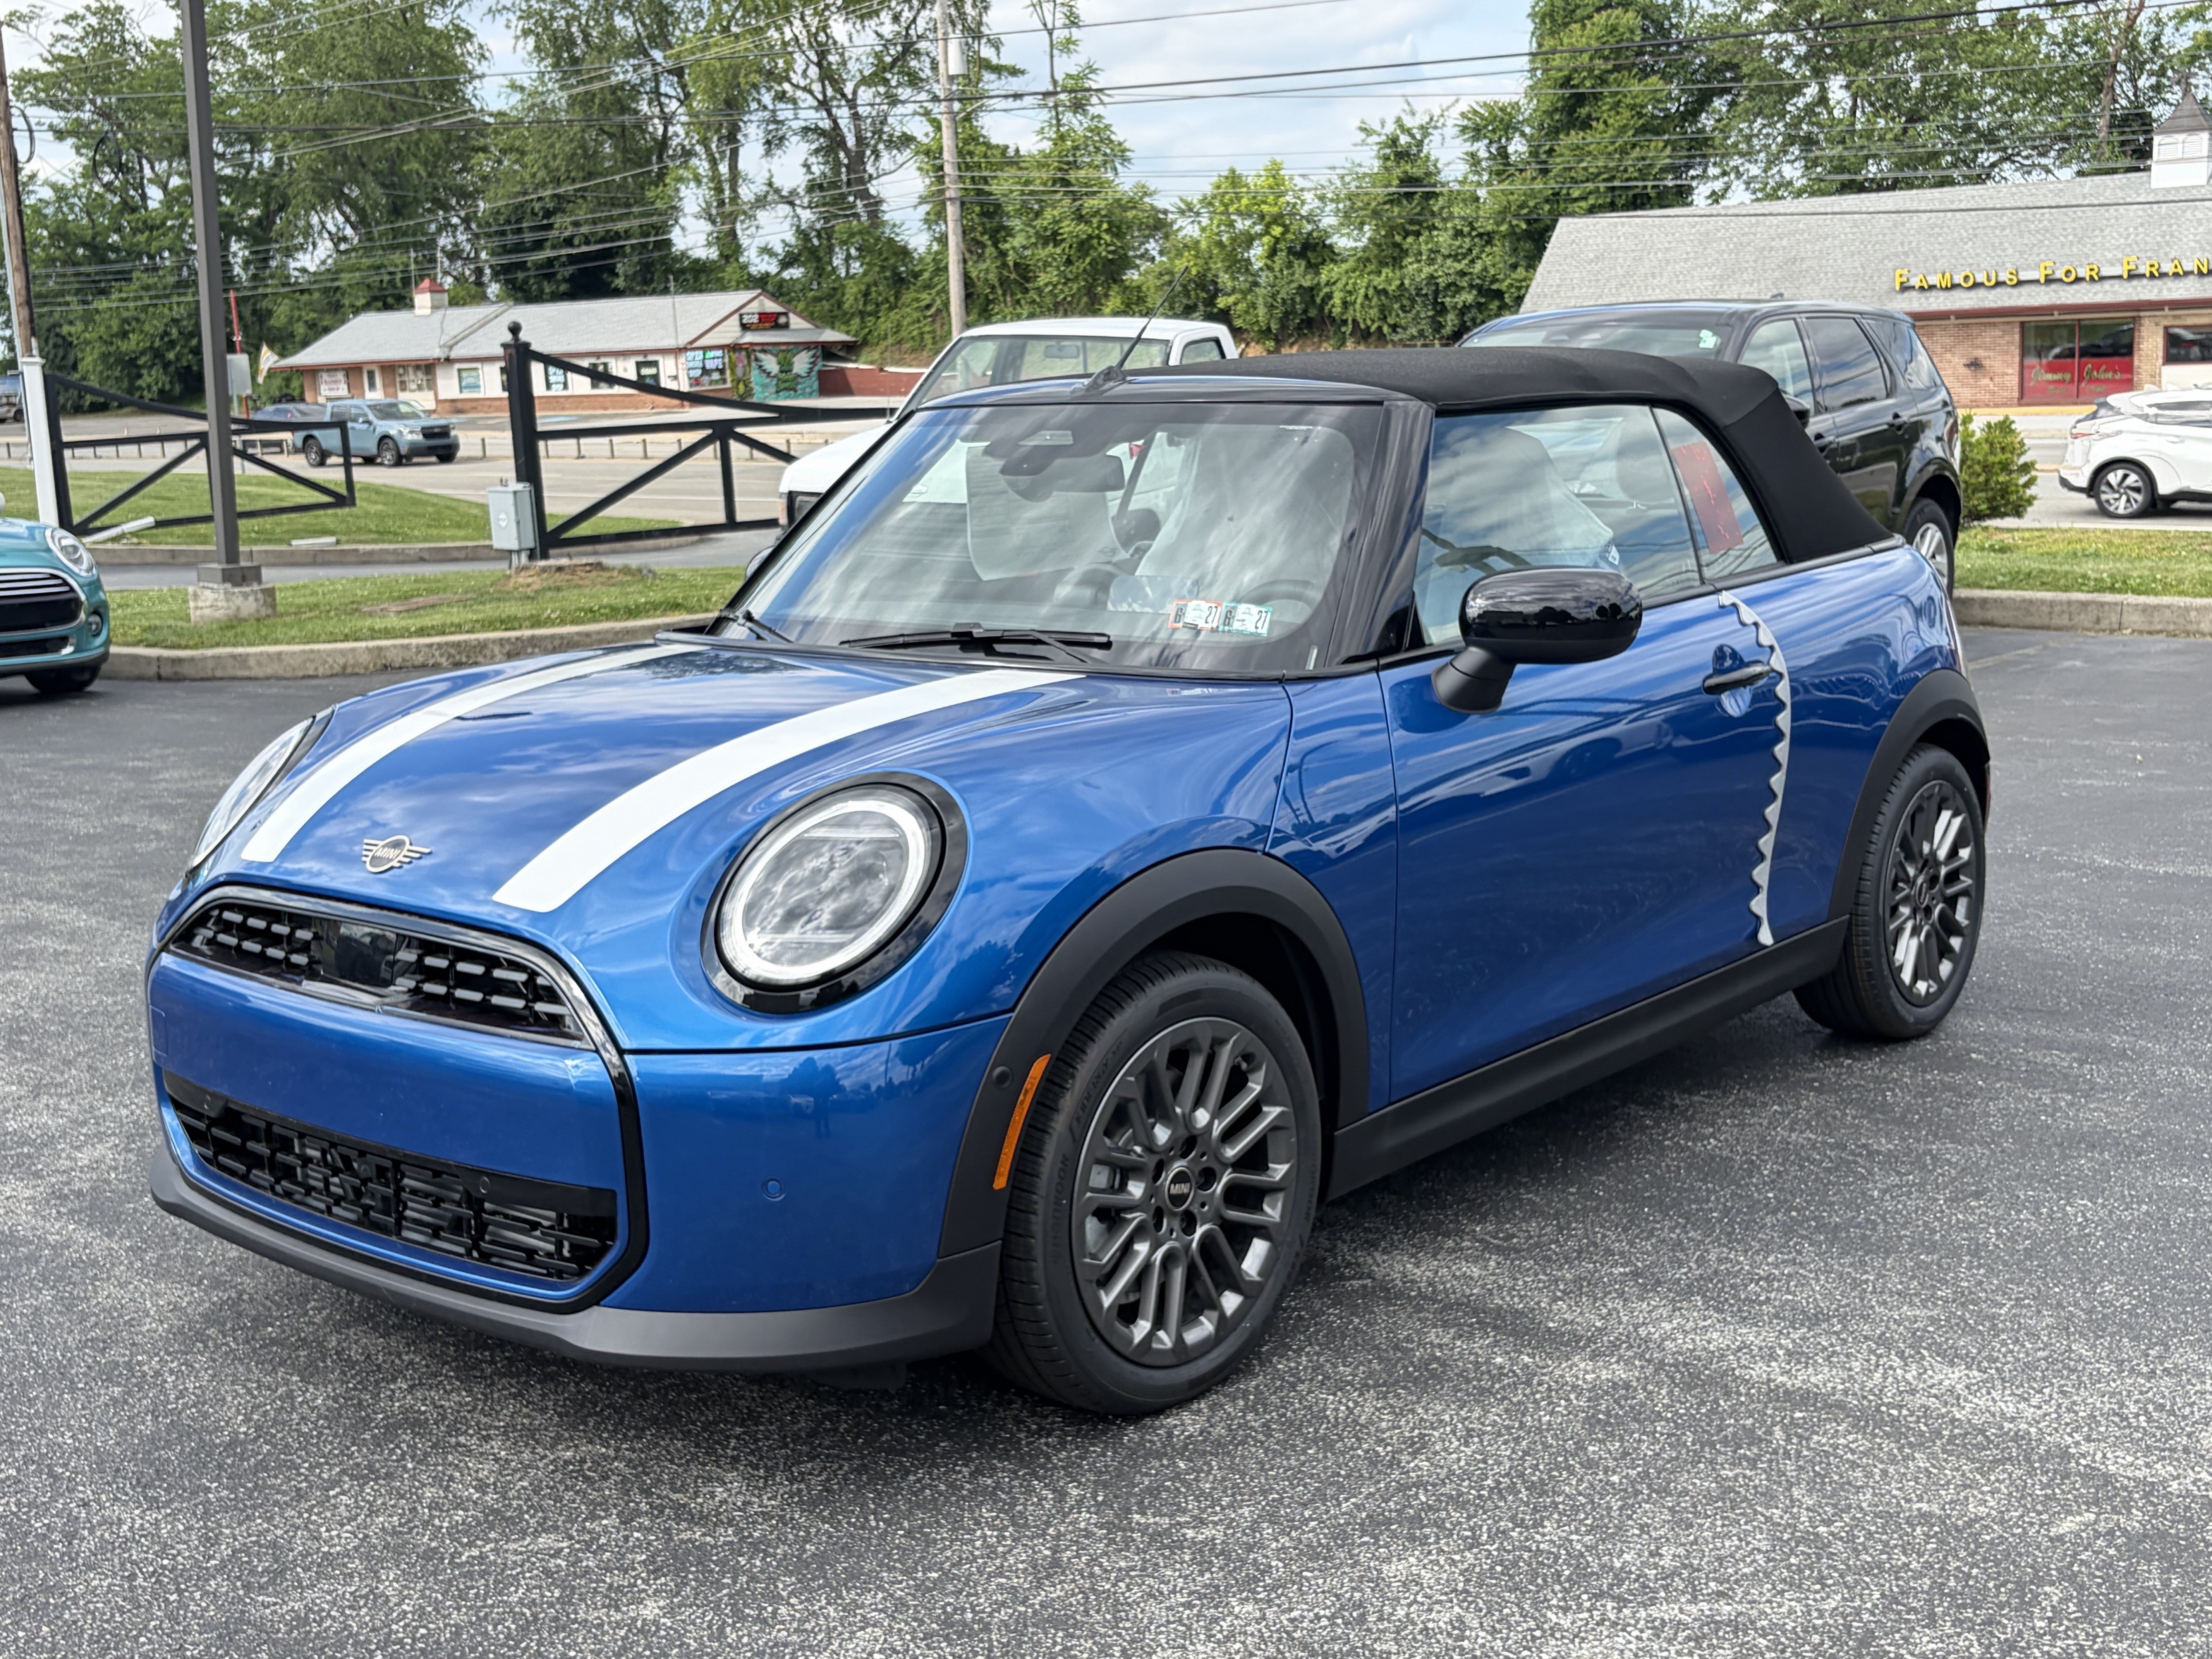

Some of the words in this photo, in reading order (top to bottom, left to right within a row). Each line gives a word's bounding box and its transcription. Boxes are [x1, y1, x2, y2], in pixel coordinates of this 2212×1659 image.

[1895, 268, 2018, 291] FAMOUS
[2039, 260, 2099, 284] FOR
[2122, 255, 2209, 280] FRAN
[1174, 607, 1183, 624] 6
[1205, 606, 1218, 625] 27
[1223, 610, 1233, 627] 6
[1255, 610, 1268, 630] 27
[374, 847, 402, 859] MINI
[1170, 1182, 1190, 1194] MINI
